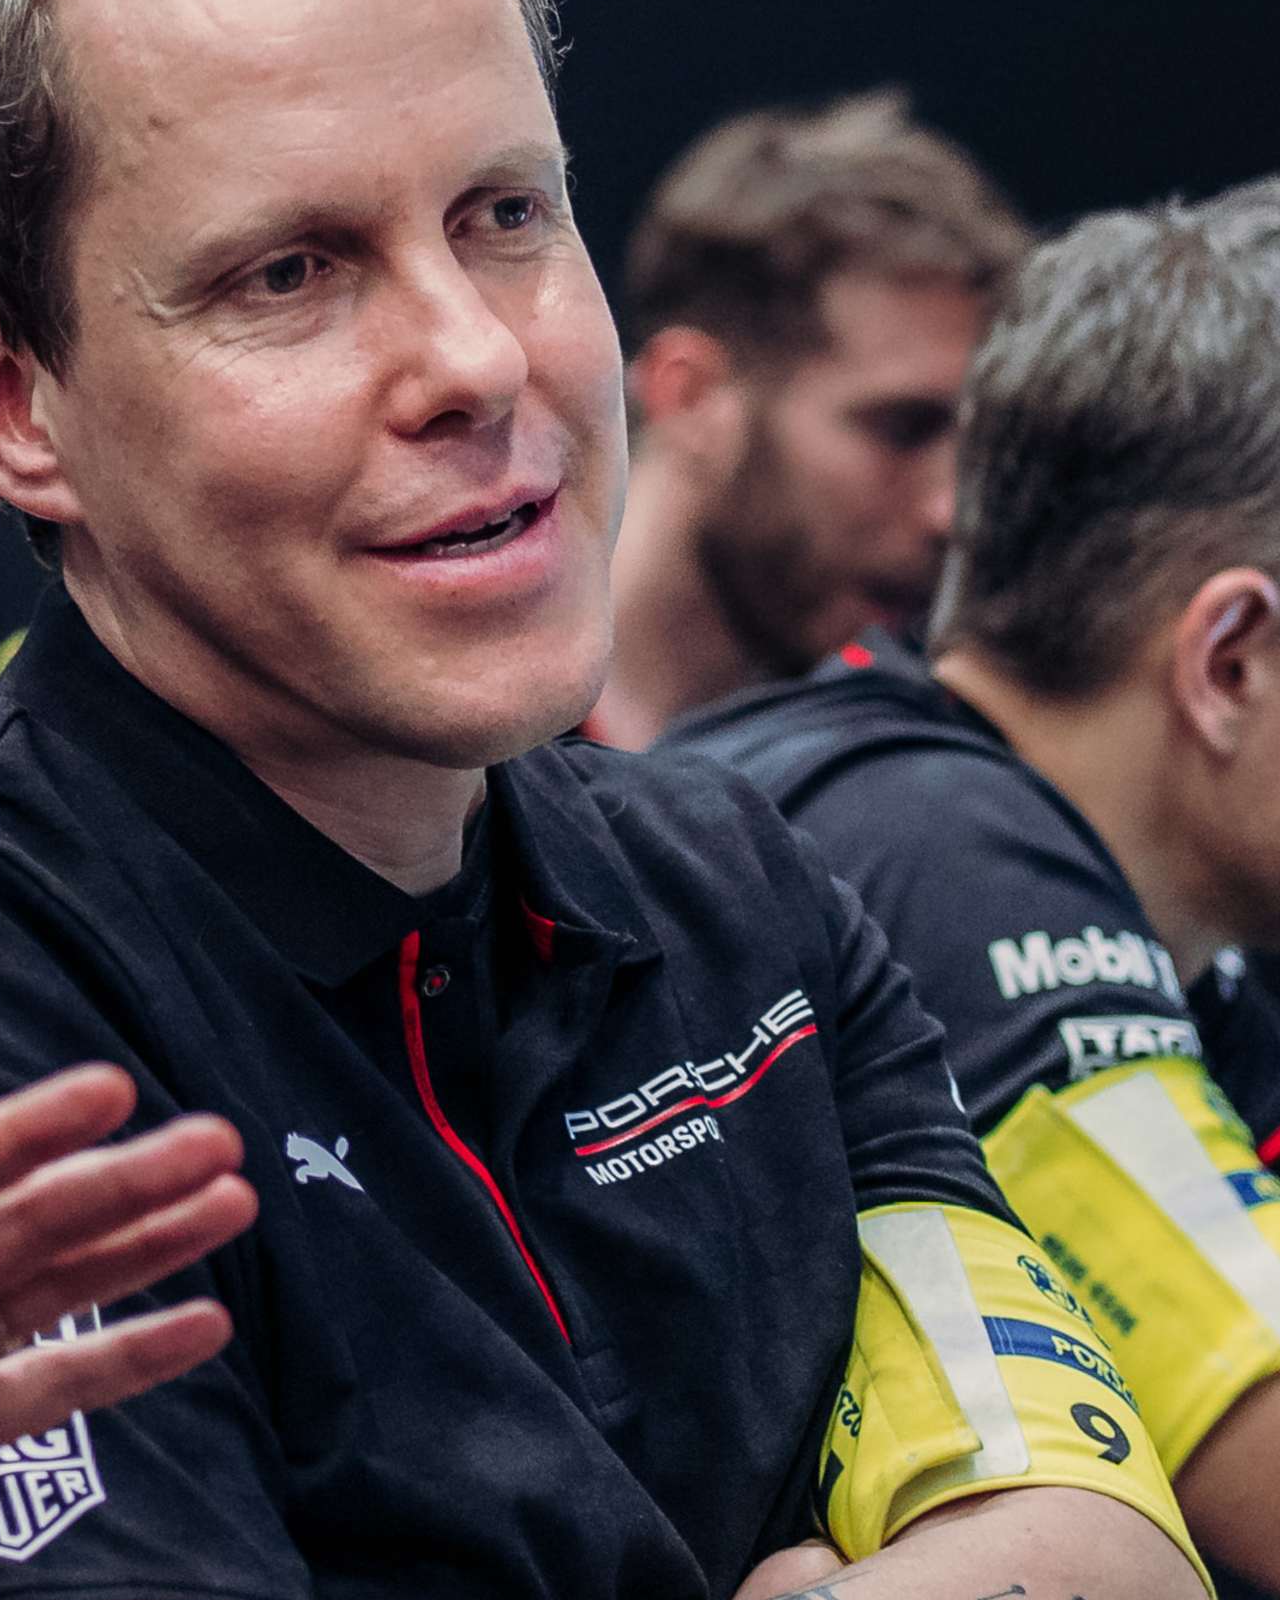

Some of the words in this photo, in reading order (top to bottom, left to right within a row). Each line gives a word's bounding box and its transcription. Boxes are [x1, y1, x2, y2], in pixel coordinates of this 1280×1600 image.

[988, 926, 1157, 1000] Mobil
[565, 989, 813, 1139] PORSCHE
[584, 1115, 724, 1185] MOTORSPO
[1070, 1403, 1131, 1465] 9
